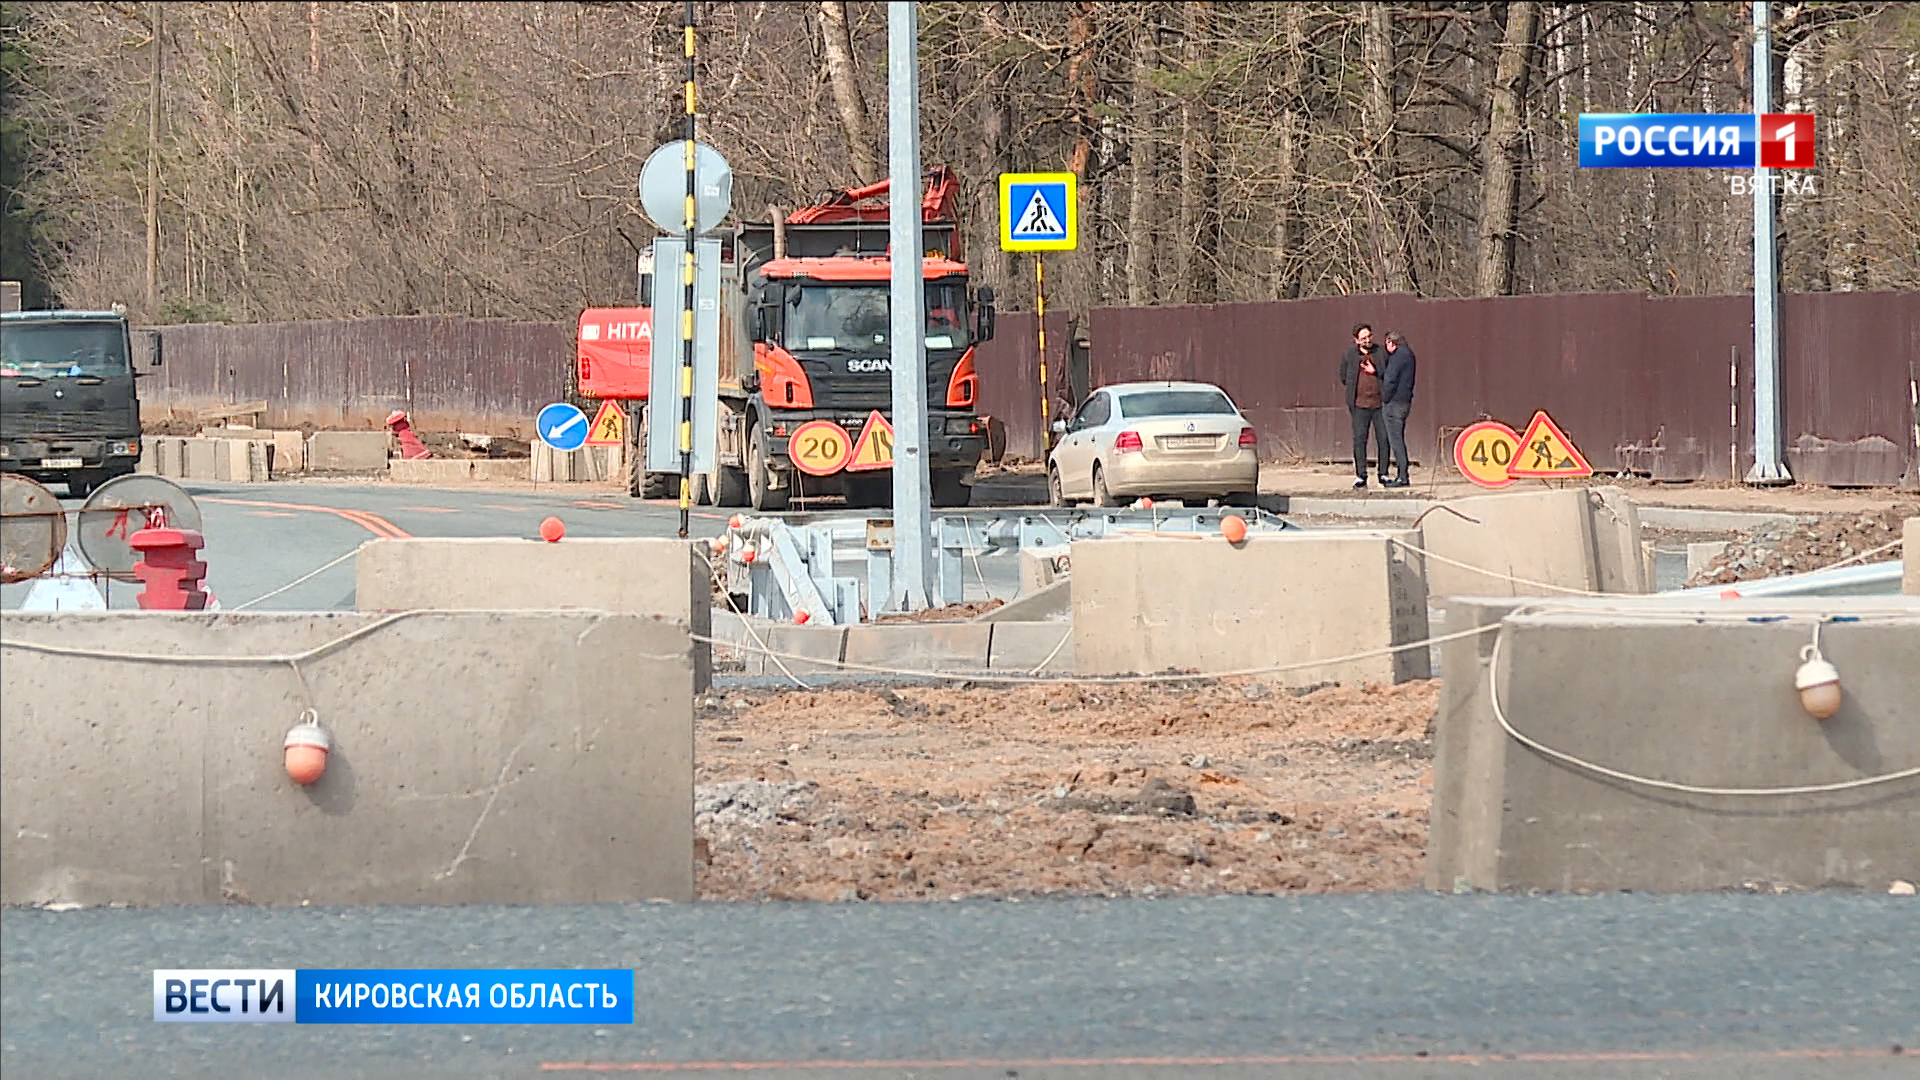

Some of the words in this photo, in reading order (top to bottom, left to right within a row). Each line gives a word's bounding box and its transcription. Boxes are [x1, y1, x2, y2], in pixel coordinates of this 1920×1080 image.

[607, 321, 652, 340] HITA
[803, 437, 838, 460] 20
[1471, 439, 1511, 466] 40
